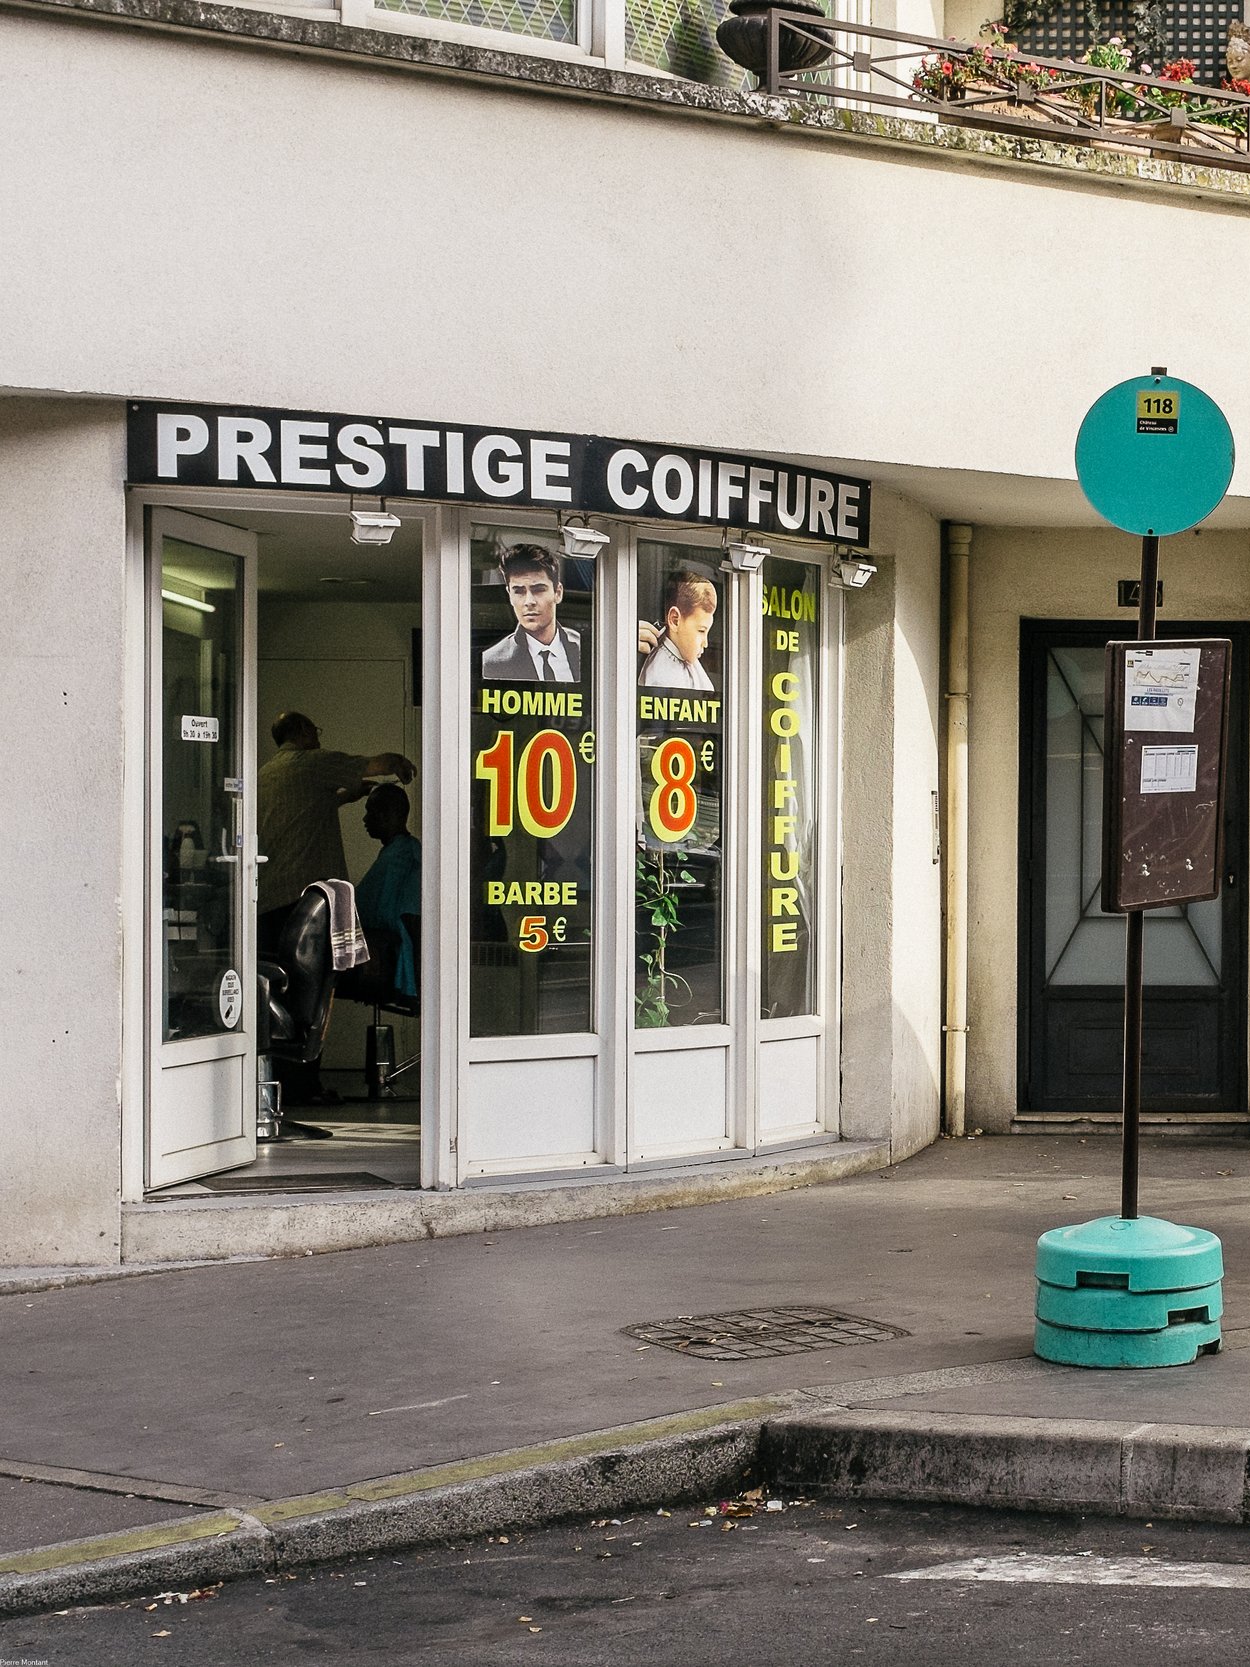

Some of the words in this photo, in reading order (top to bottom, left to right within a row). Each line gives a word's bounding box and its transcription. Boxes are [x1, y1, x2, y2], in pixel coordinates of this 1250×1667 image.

[1143, 398, 1173, 415] 118
[156, 412, 573, 503] PRESTIGE
[606, 448, 861, 541] COIFFURE
[761, 583, 815, 623] SALON
[776, 629, 800, 653] DE
[482, 688, 583, 718] HOMME
[640, 695, 721, 724] ENFANT
[769, 671, 801, 953] COIFFURE
[487, 881, 578, 905] BARBE
